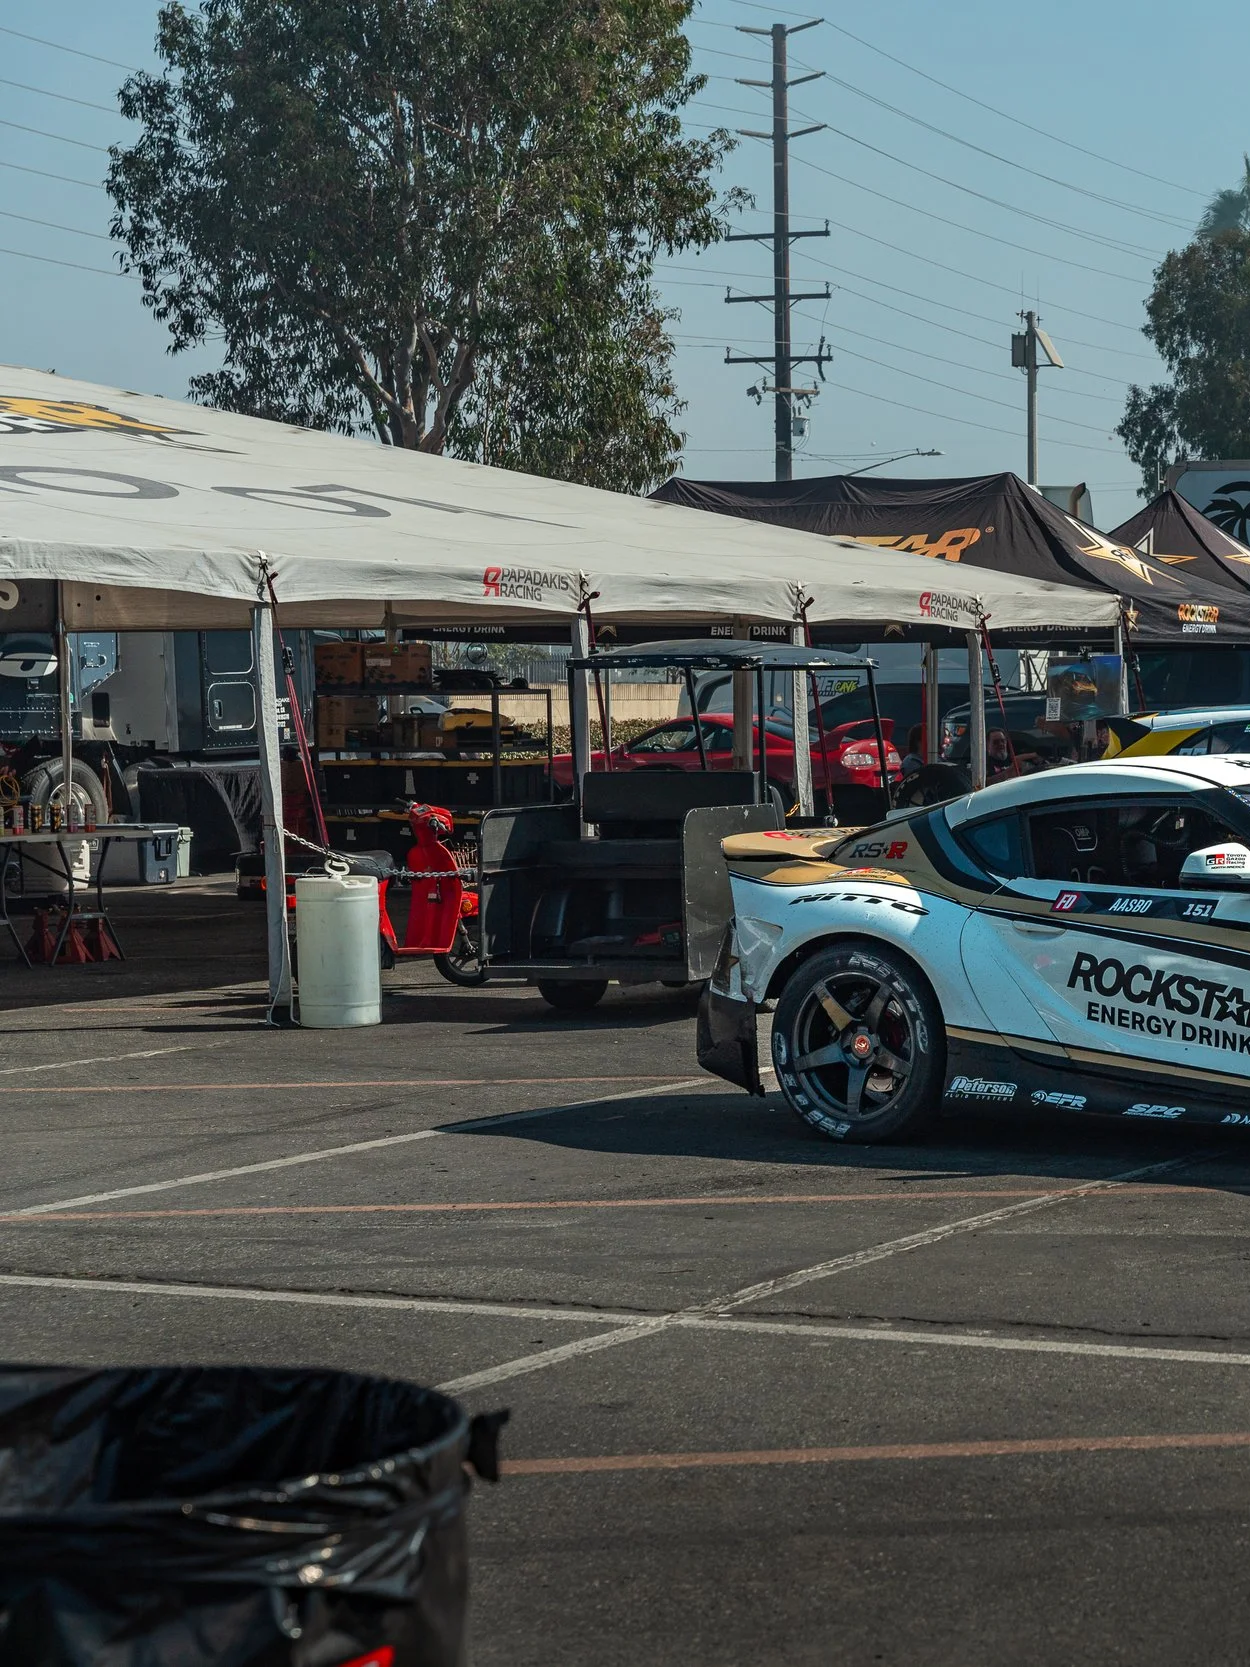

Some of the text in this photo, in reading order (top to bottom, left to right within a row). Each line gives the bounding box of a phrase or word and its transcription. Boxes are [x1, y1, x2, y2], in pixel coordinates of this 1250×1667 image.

[501, 568, 569, 591] PAPADAKIS
[500, 583, 542, 601] RACING
[931, 605, 958, 622] RACING
[1178, 604, 1219, 623] ROCKSTAR
[753, 626, 787, 636] DRINK
[1183, 624, 1216, 633] ENERGY DRINK
[1206, 856, 1225, 866] GR
[788, 893, 931, 916] NITTO
[1055, 894, 1213, 917] FD AASBO 151
[1087, 1001, 1177, 1038] ENERGY
[950, 1078, 1015, 1094] Peterson
[1045, 1092, 1087, 1108] EFR
[1127, 1103, 1186, 1116] SPC
